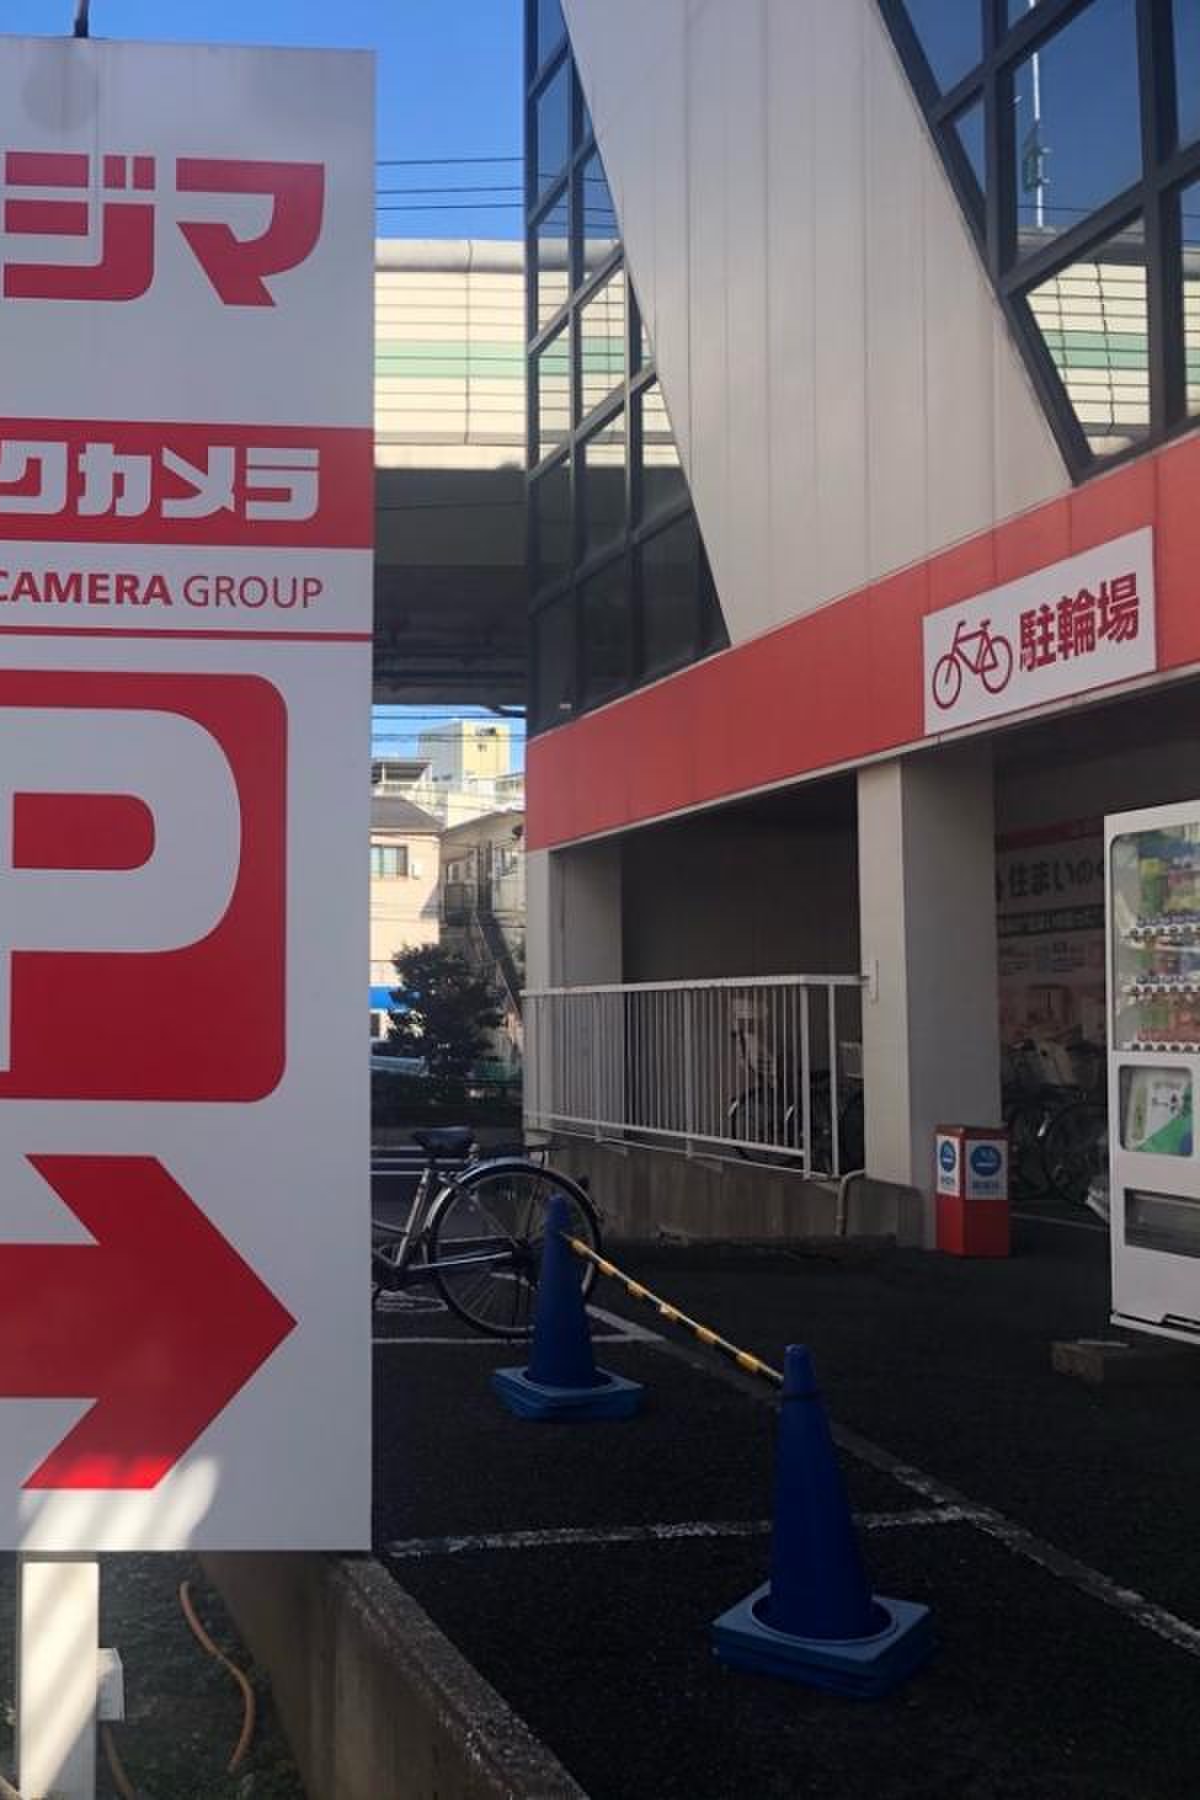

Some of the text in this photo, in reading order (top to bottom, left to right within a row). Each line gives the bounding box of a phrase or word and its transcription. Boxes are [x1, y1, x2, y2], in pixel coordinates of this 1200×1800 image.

[182, 575, 323, 609] GROUP
[1019, 572, 1140, 672] 駐輪場
